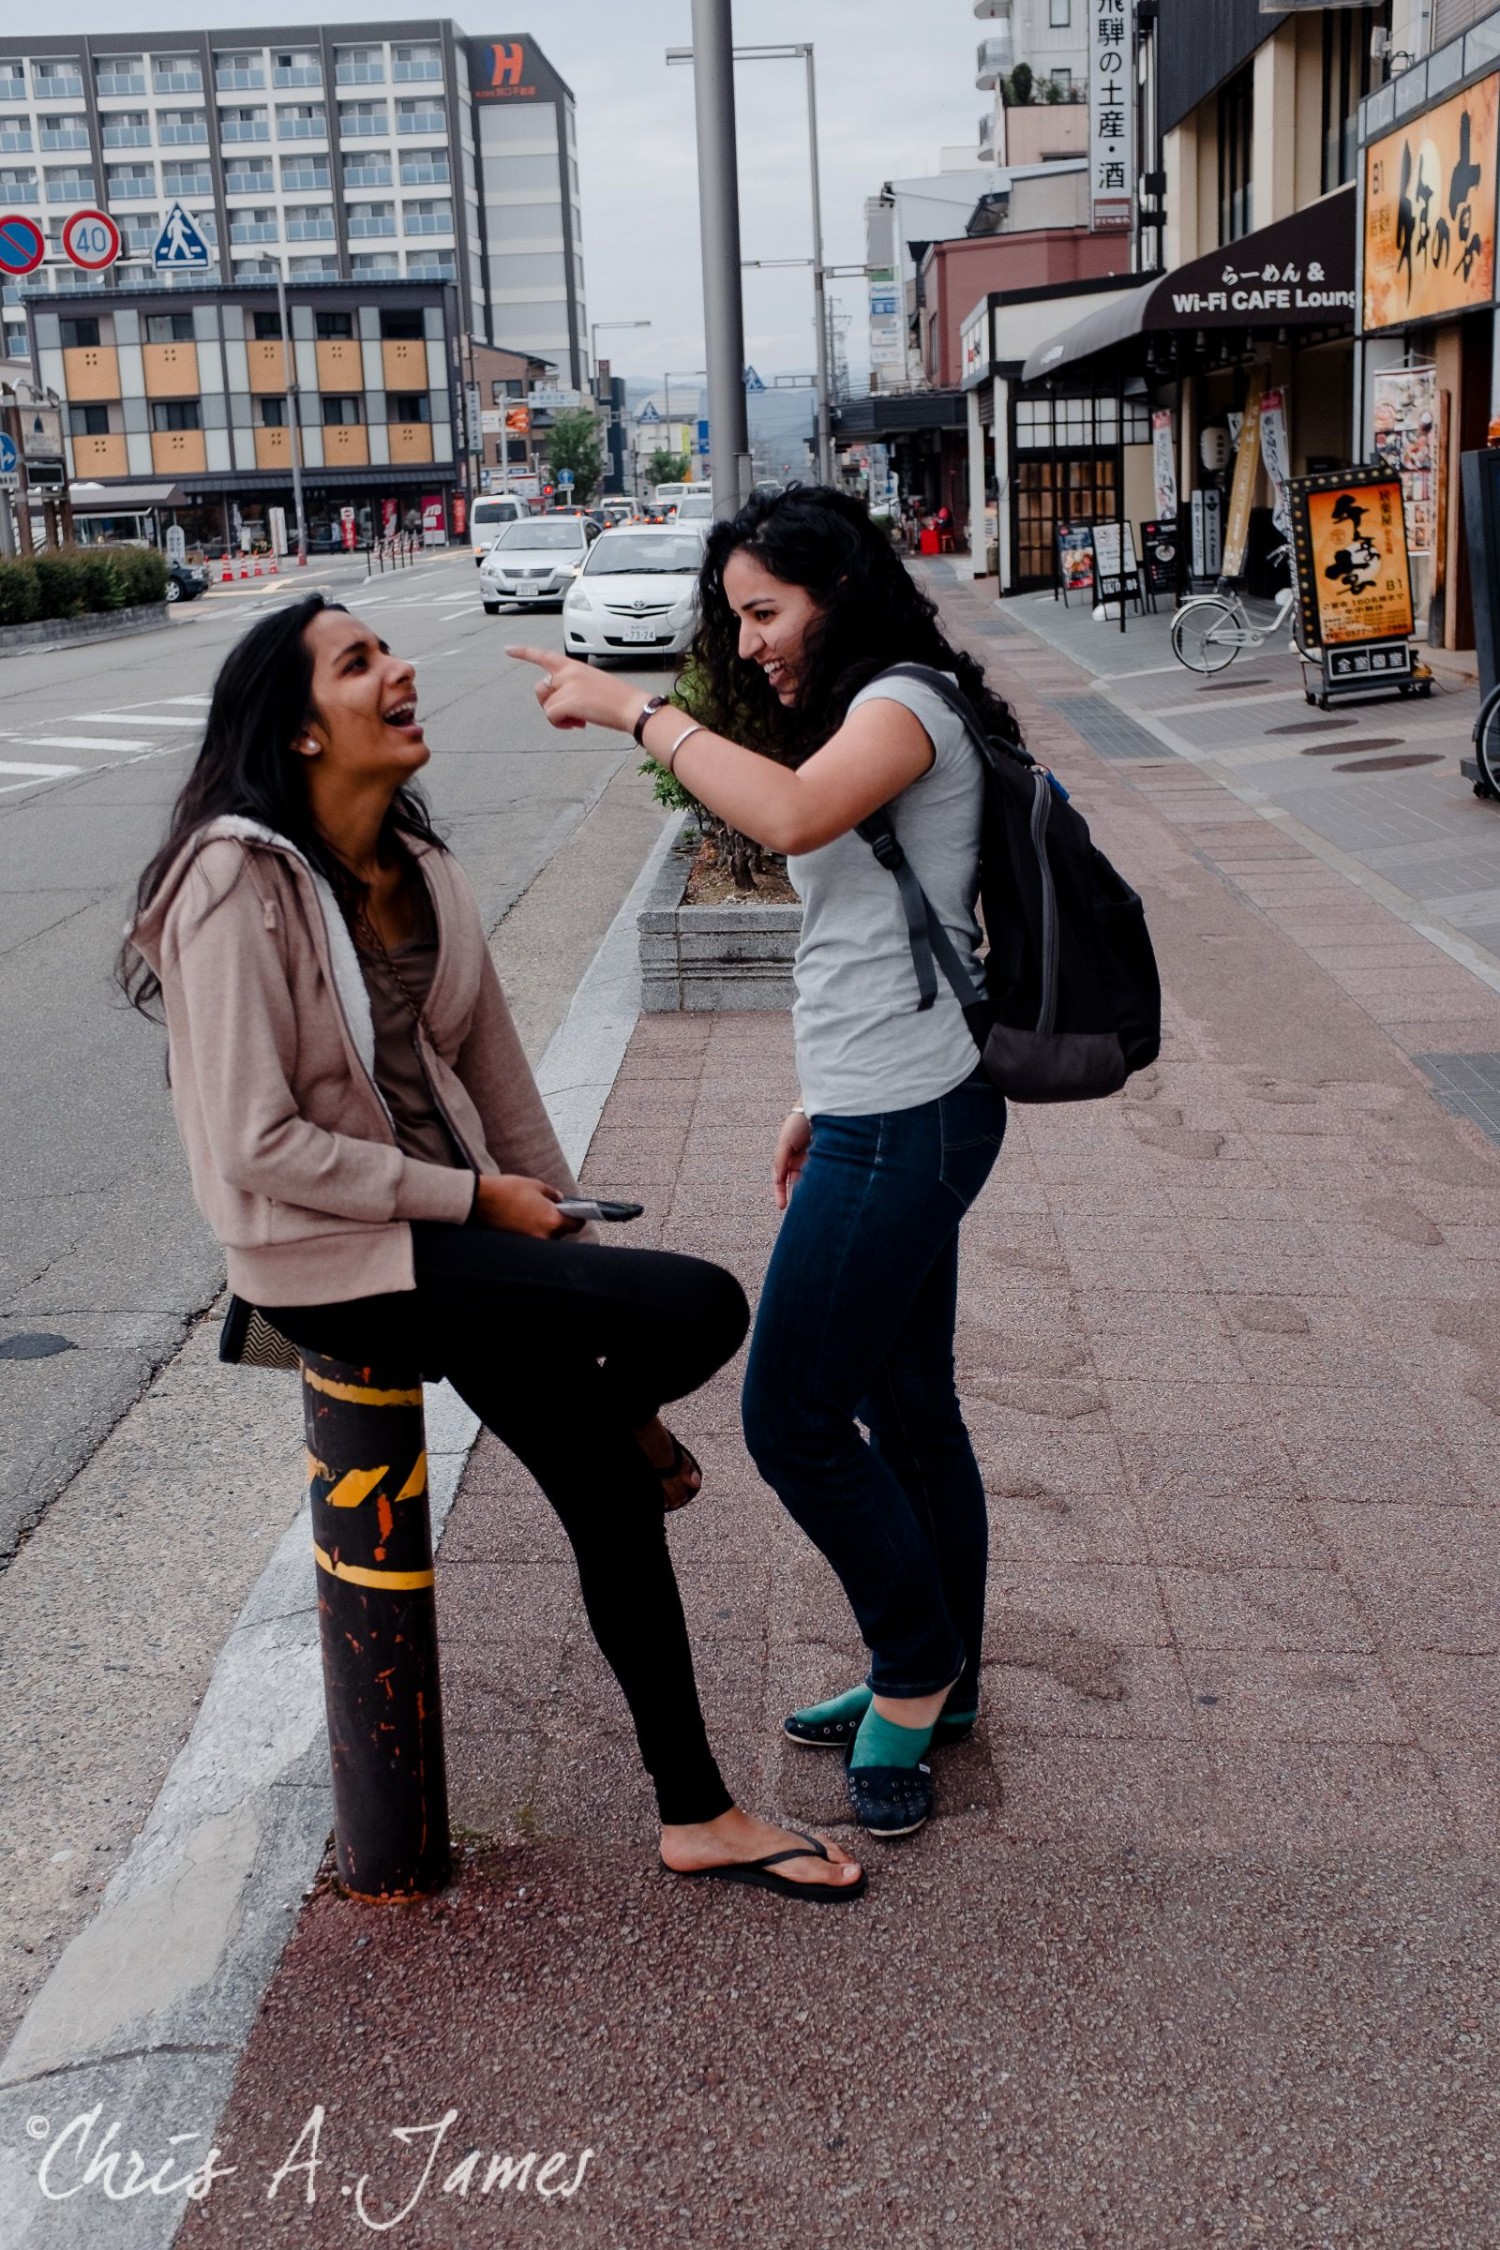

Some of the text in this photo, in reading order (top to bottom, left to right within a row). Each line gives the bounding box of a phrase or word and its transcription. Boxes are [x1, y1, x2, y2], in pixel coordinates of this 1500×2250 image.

[76, 226, 107, 253] 40
[1221, 262, 1325, 286] らーめん &
[1172, 292, 1228, 313] Wi-Fi
[1231, 289, 1291, 311] CAFE
[1386, 578, 1403, 591] B1
